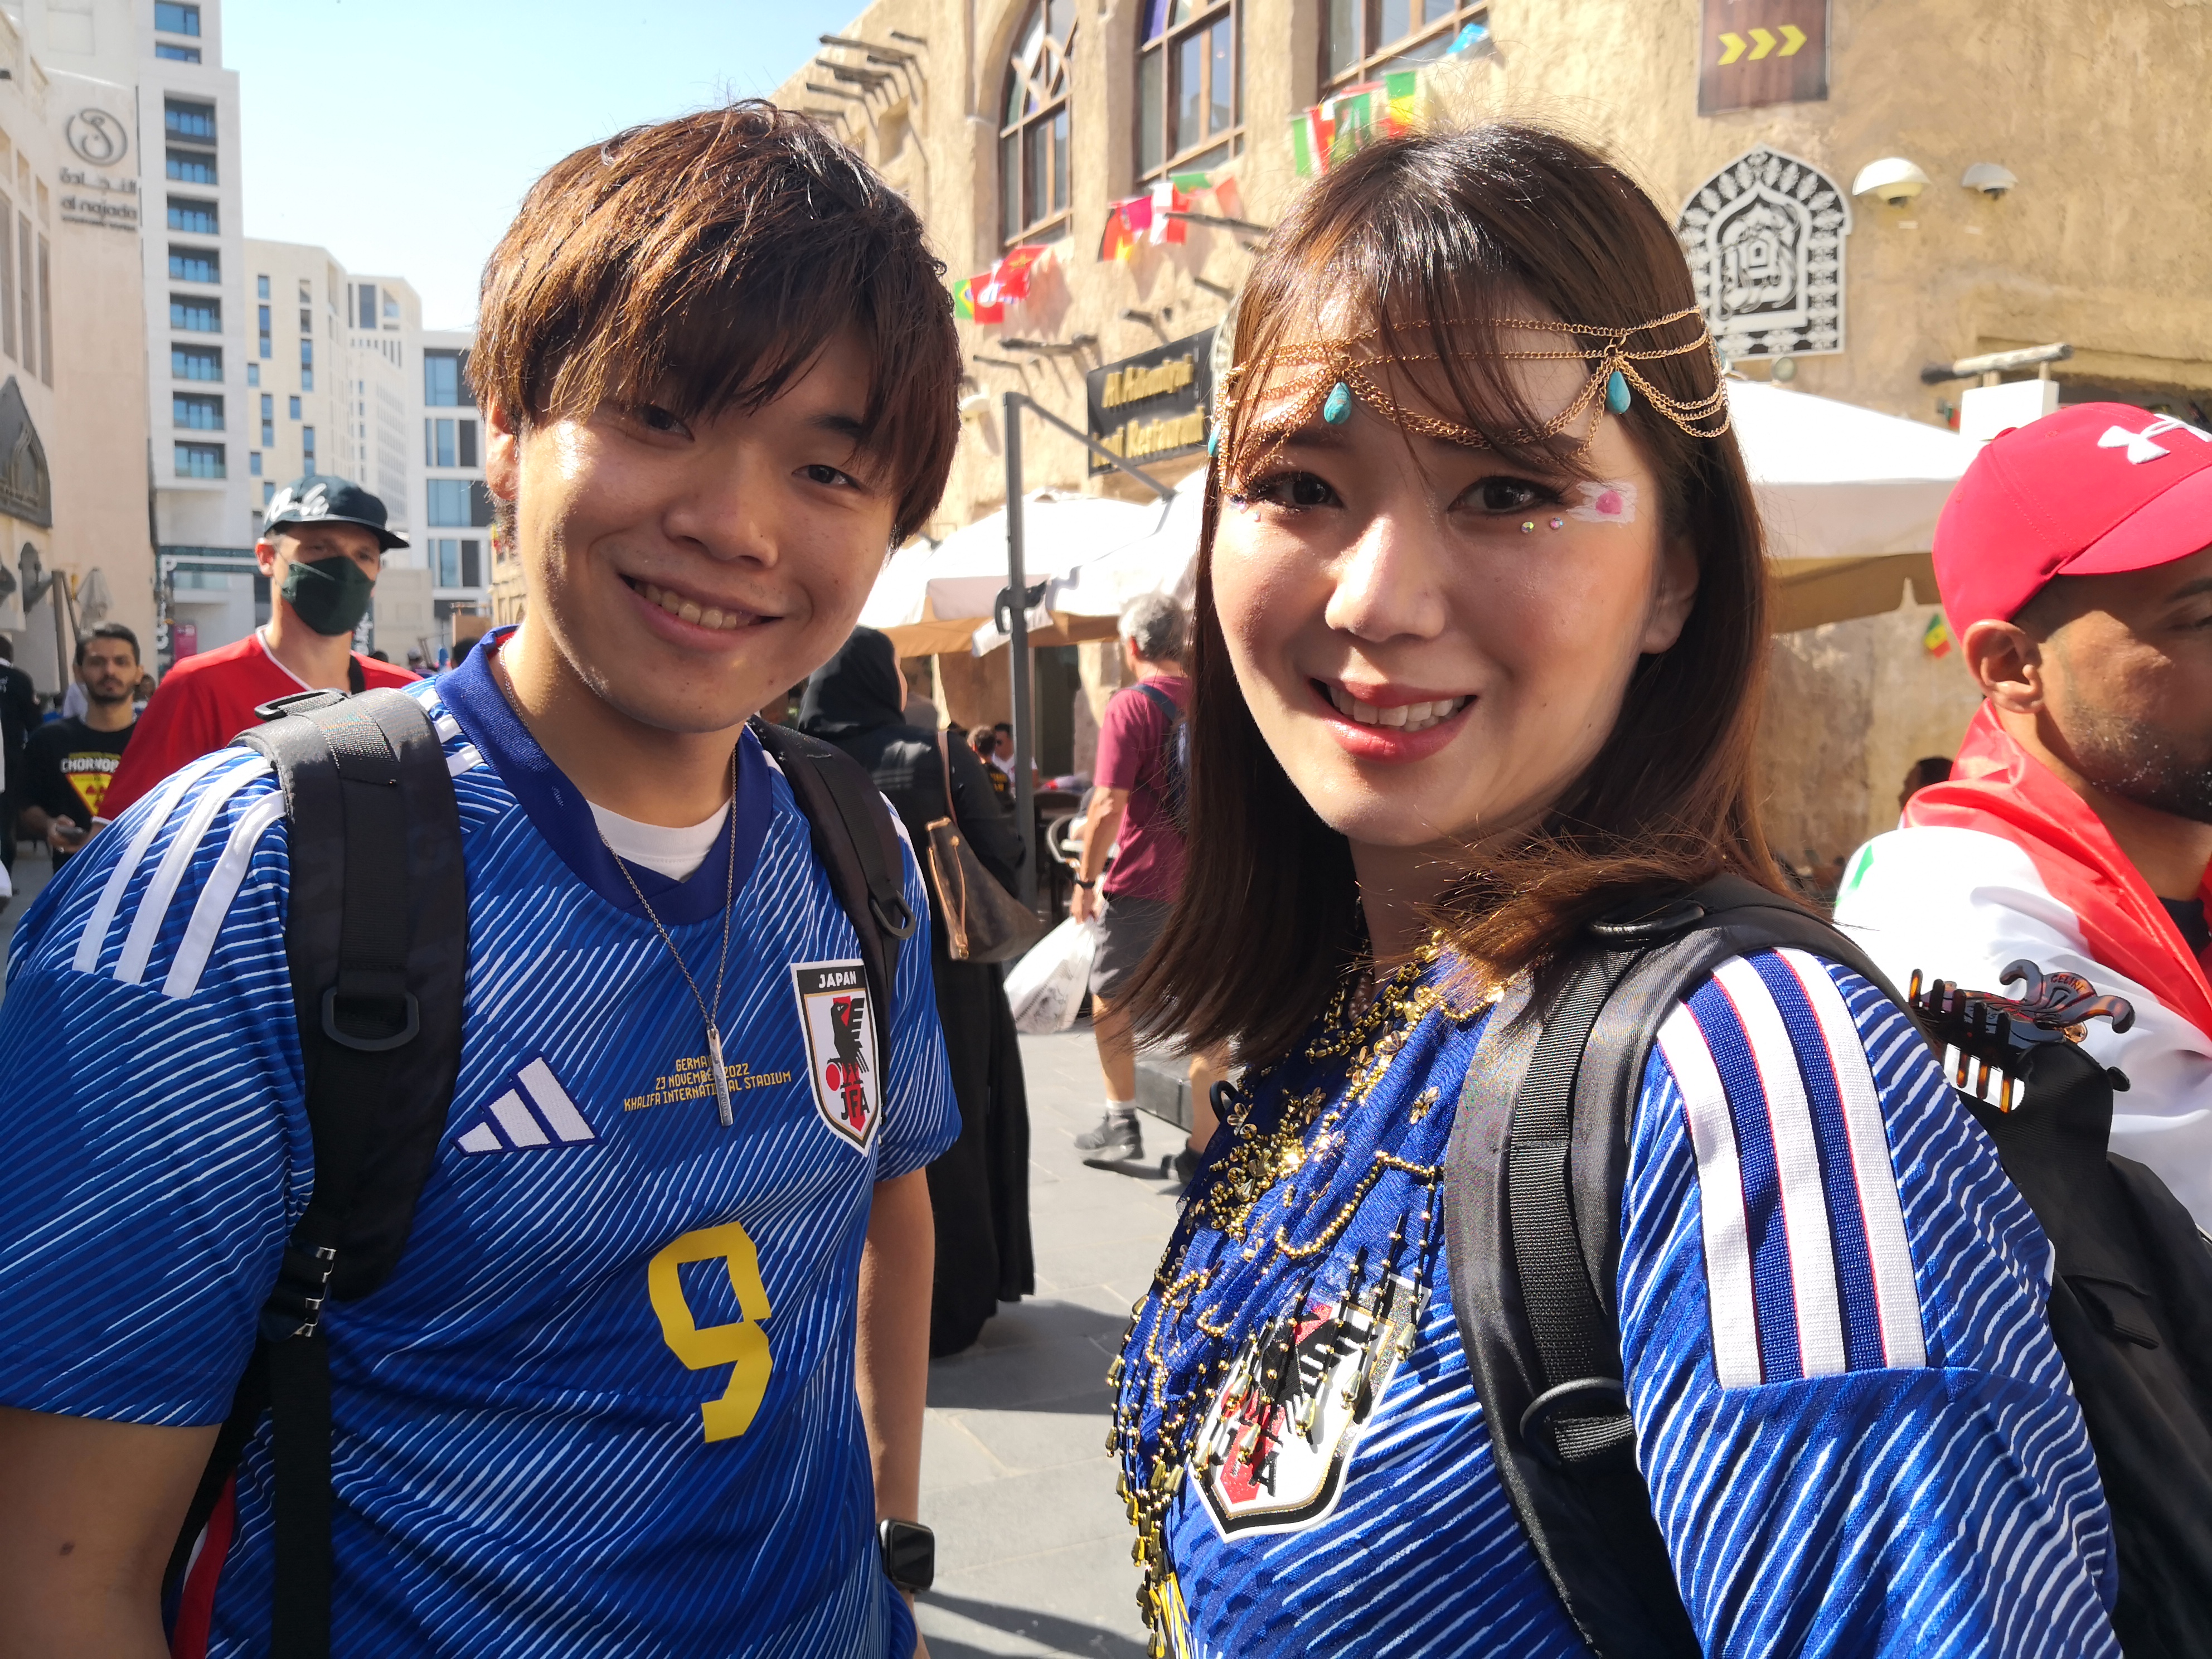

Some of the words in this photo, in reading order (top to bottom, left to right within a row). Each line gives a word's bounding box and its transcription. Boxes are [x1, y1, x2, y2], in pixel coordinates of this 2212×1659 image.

[61, 195, 75, 210] al
[81, 199, 138, 222] najada
[818, 971, 857, 988] JAPAN
[2051, 974, 2087, 993] CELINE
[656, 1076, 666, 1090] 23
[668, 1069, 714, 1088] NOVEMBE
[724, 1063, 750, 1078] 2022
[624, 1093, 661, 1112] KHALIFA
[663, 1079, 743, 1104] INTERNATIAL
[744, 1070, 792, 1089] STADIUM
[841, 1087, 870, 1120] JFA
[648, 1220, 773, 1444] 9
